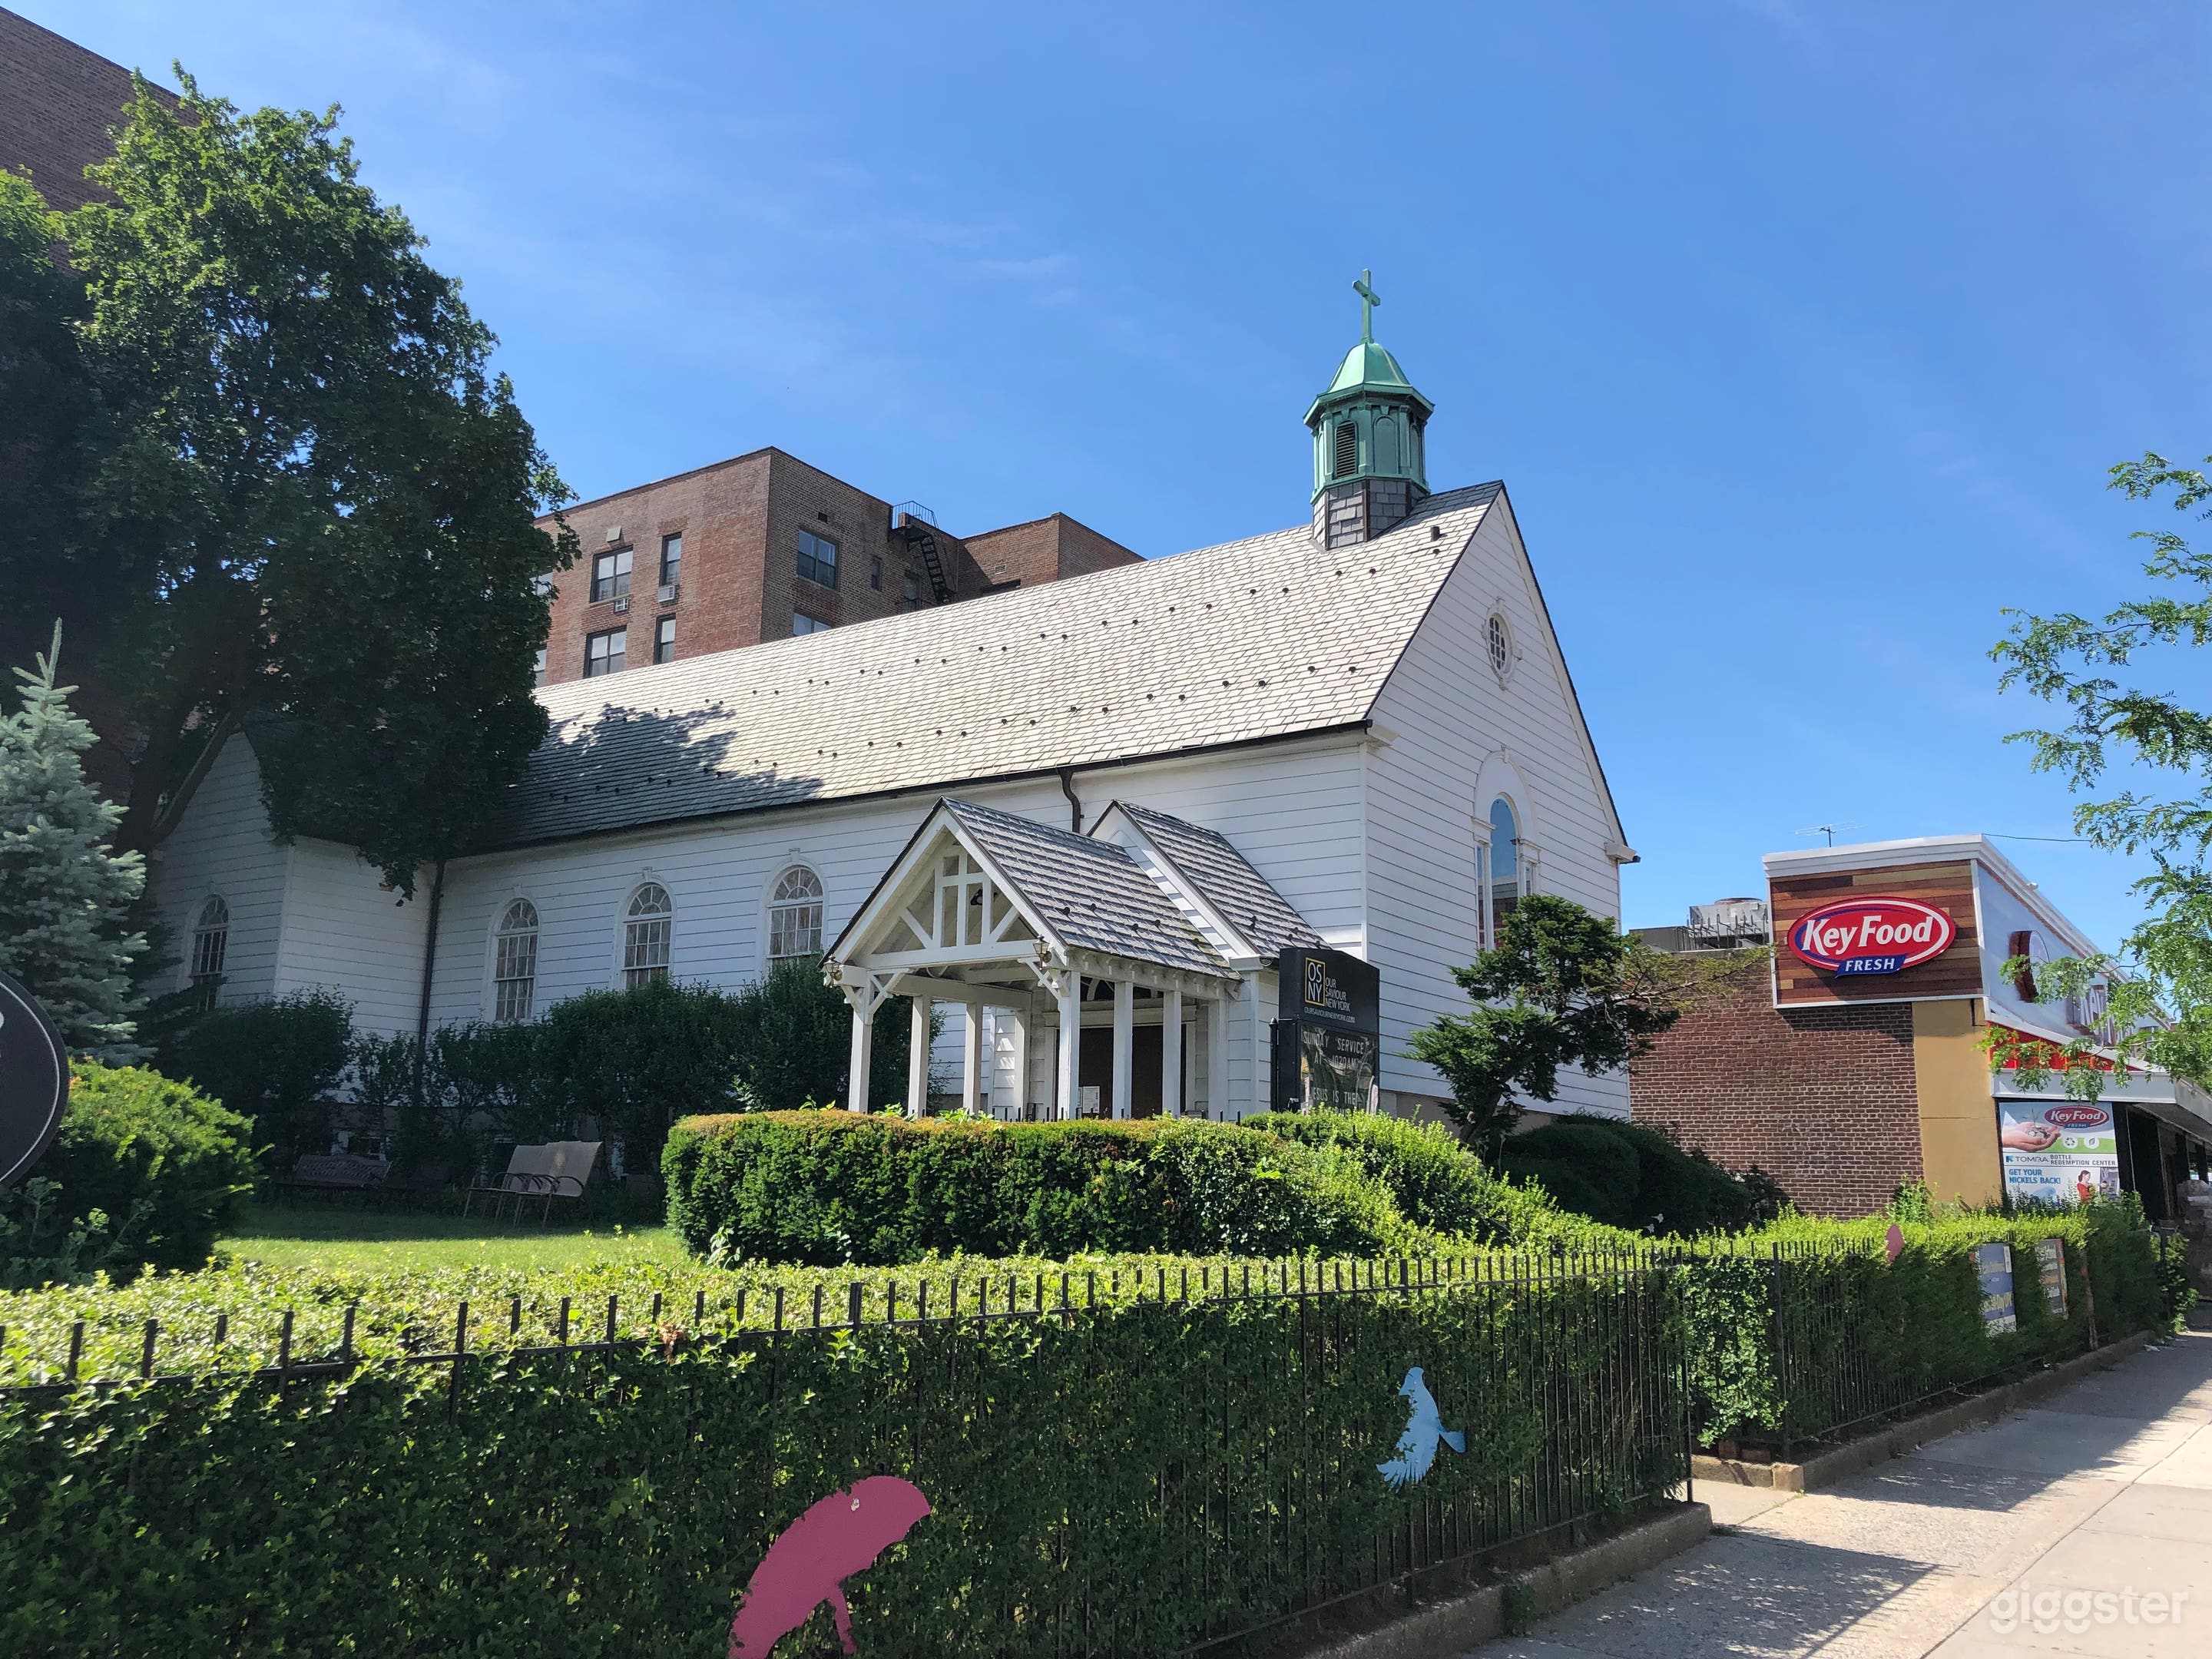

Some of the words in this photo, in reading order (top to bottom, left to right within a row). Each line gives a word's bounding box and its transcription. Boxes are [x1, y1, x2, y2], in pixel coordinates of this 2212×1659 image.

[1801, 918, 1858, 956] Key
[1858, 915, 1933, 947] Food
[1308, 962, 1322, 982] OS
[1845, 958, 1895, 972] FRESH
[1325, 977, 1336, 988] OUR
[1308, 981, 1322, 1002] NY
[1325, 987, 1346, 1001] SAVIOUR
[1325, 998, 1336, 1009] NEW
[1337, 1000, 1350, 1012] YORK
[1303, 1031, 1330, 1048] SUNDAY
[1337, 1038, 1364, 1055] SERVICE
[1310, 1087, 1328, 1101] JESUS
[1333, 1090, 1339, 1103] IS
[2050, 1111, 2073, 1124] Key
[2073, 1110, 2101, 1121] Food
